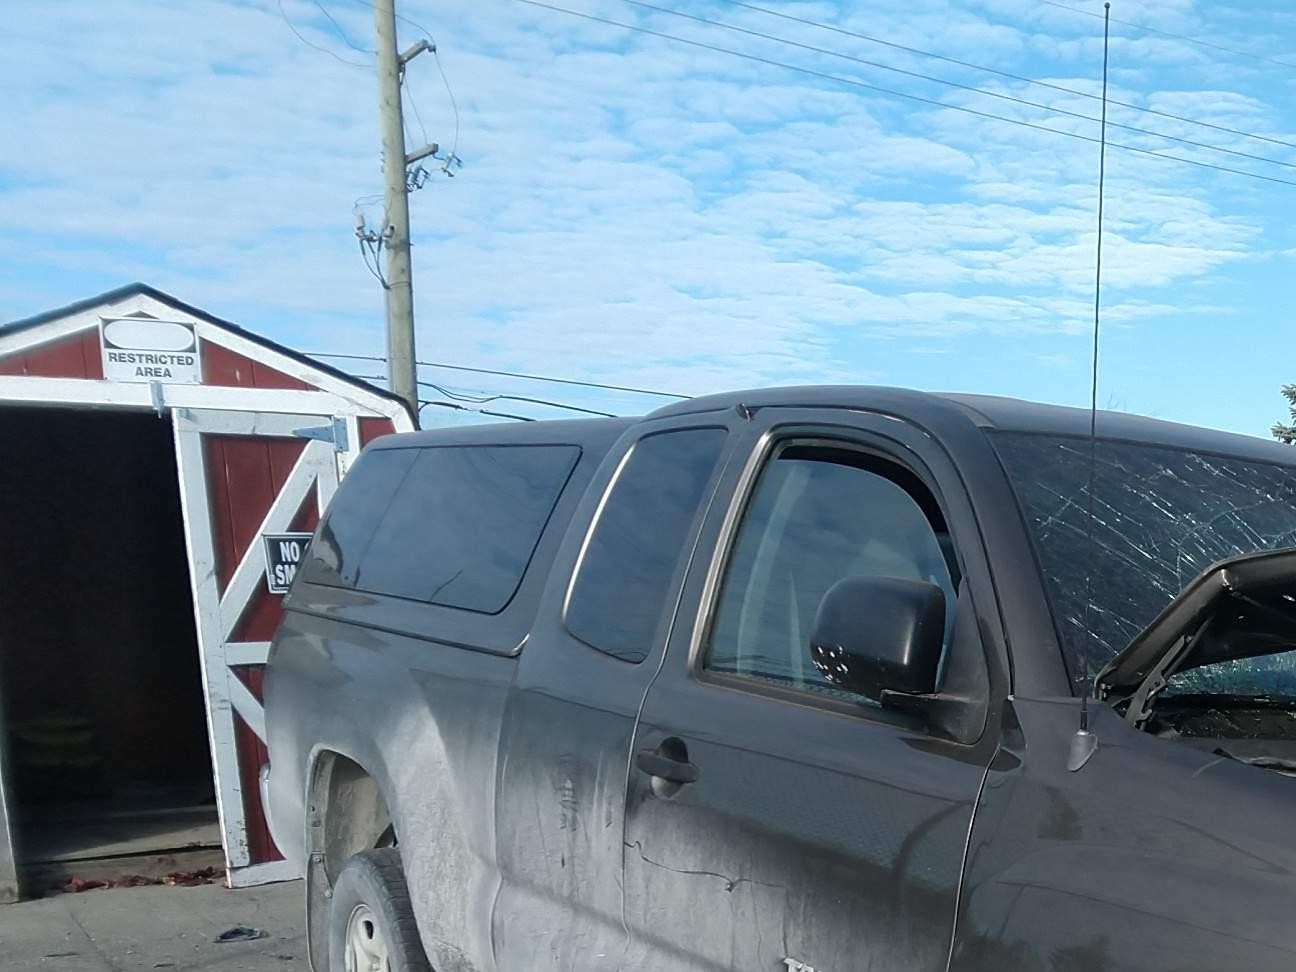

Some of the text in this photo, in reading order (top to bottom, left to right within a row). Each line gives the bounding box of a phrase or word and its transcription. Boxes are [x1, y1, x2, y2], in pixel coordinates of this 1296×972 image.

[108, 352, 194, 366] RESTRICTED
[135, 366, 172, 378] AREA
[279, 541, 300, 562] NO
